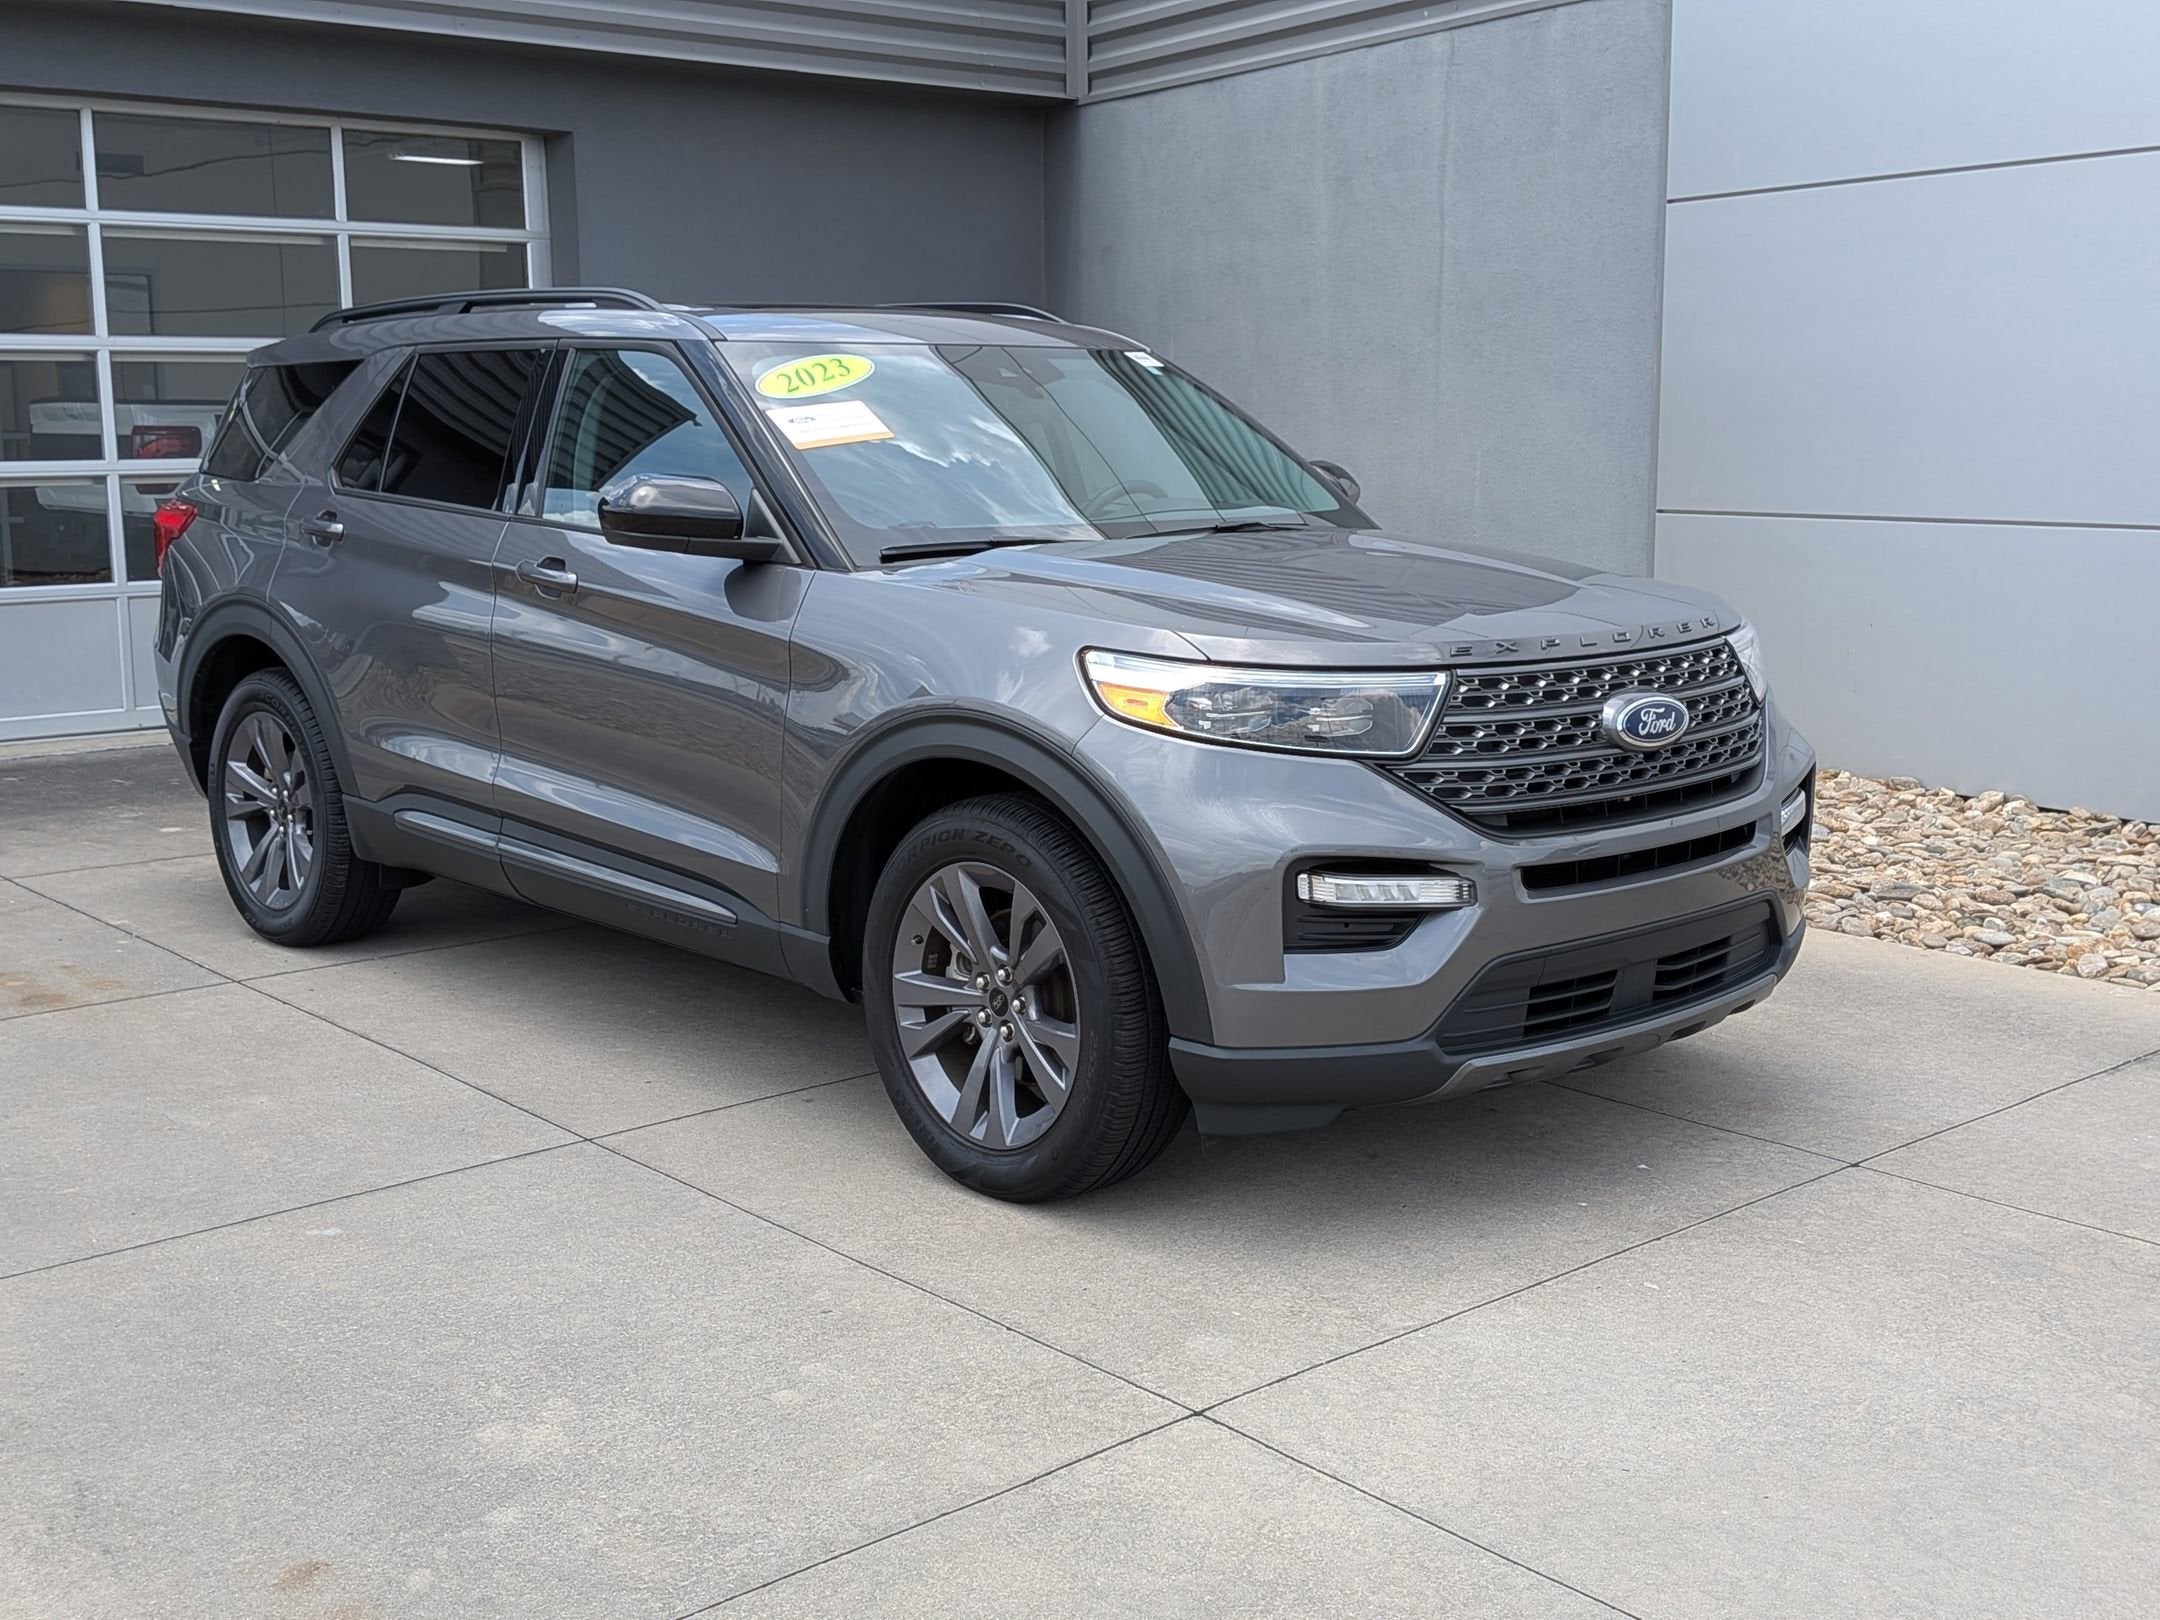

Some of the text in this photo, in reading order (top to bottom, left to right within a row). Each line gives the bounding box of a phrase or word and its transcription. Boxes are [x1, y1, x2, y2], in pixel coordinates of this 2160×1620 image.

[776, 358, 850, 393] 2023
[1450, 616, 1715, 657] EXPLORER
[1637, 707, 1677, 736] Ford
[891, 828, 1032, 880] ORPION ZERO
